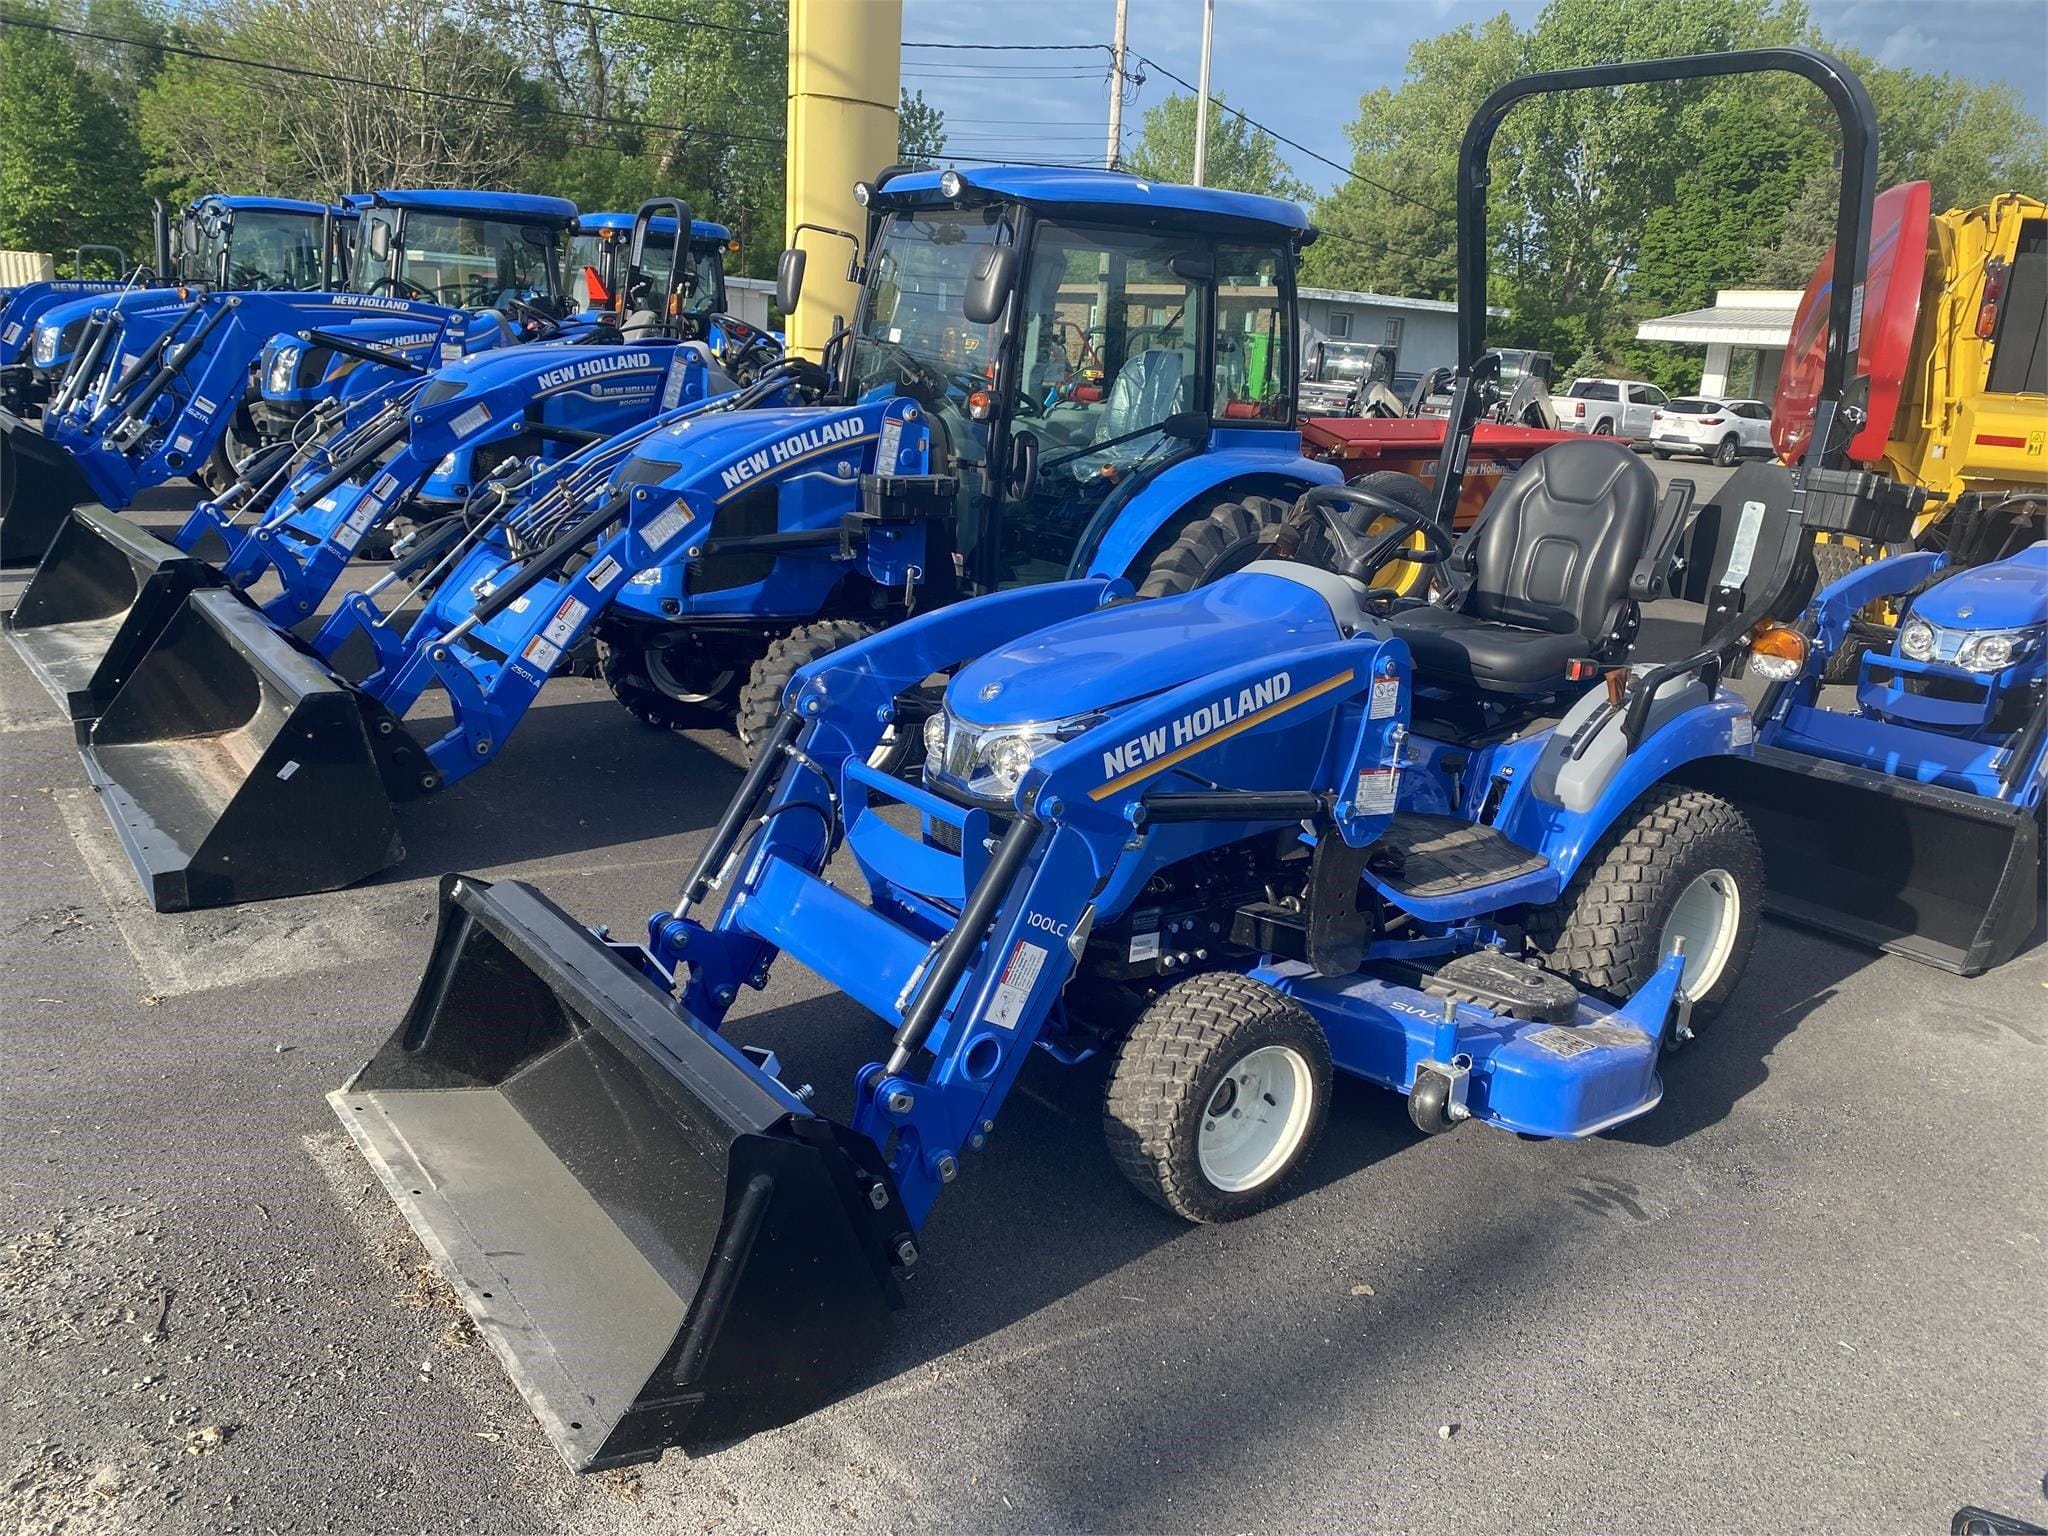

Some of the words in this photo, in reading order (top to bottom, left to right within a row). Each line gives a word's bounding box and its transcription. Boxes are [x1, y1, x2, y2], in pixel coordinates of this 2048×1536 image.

[50, 283, 79, 292] NEW
[332, 295, 358, 306] NEW
[359, 297, 409, 311] HOLLAND
[395, 332, 438, 347] HOLLAN
[537, 365, 575, 390] NEW
[577, 352, 650, 378] HOLLAND
[603, 387, 624, 395] NEW
[625, 384, 657, 393] HOLLAN
[720, 449, 770, 490] NEW
[771, 416, 865, 464] HOLLAND
[510, 663, 541, 689] 250TLA
[1102, 726, 1167, 779] NEW
[1172, 671, 1292, 747] HOLLAND
[1027, 910, 1068, 938] 100LC
